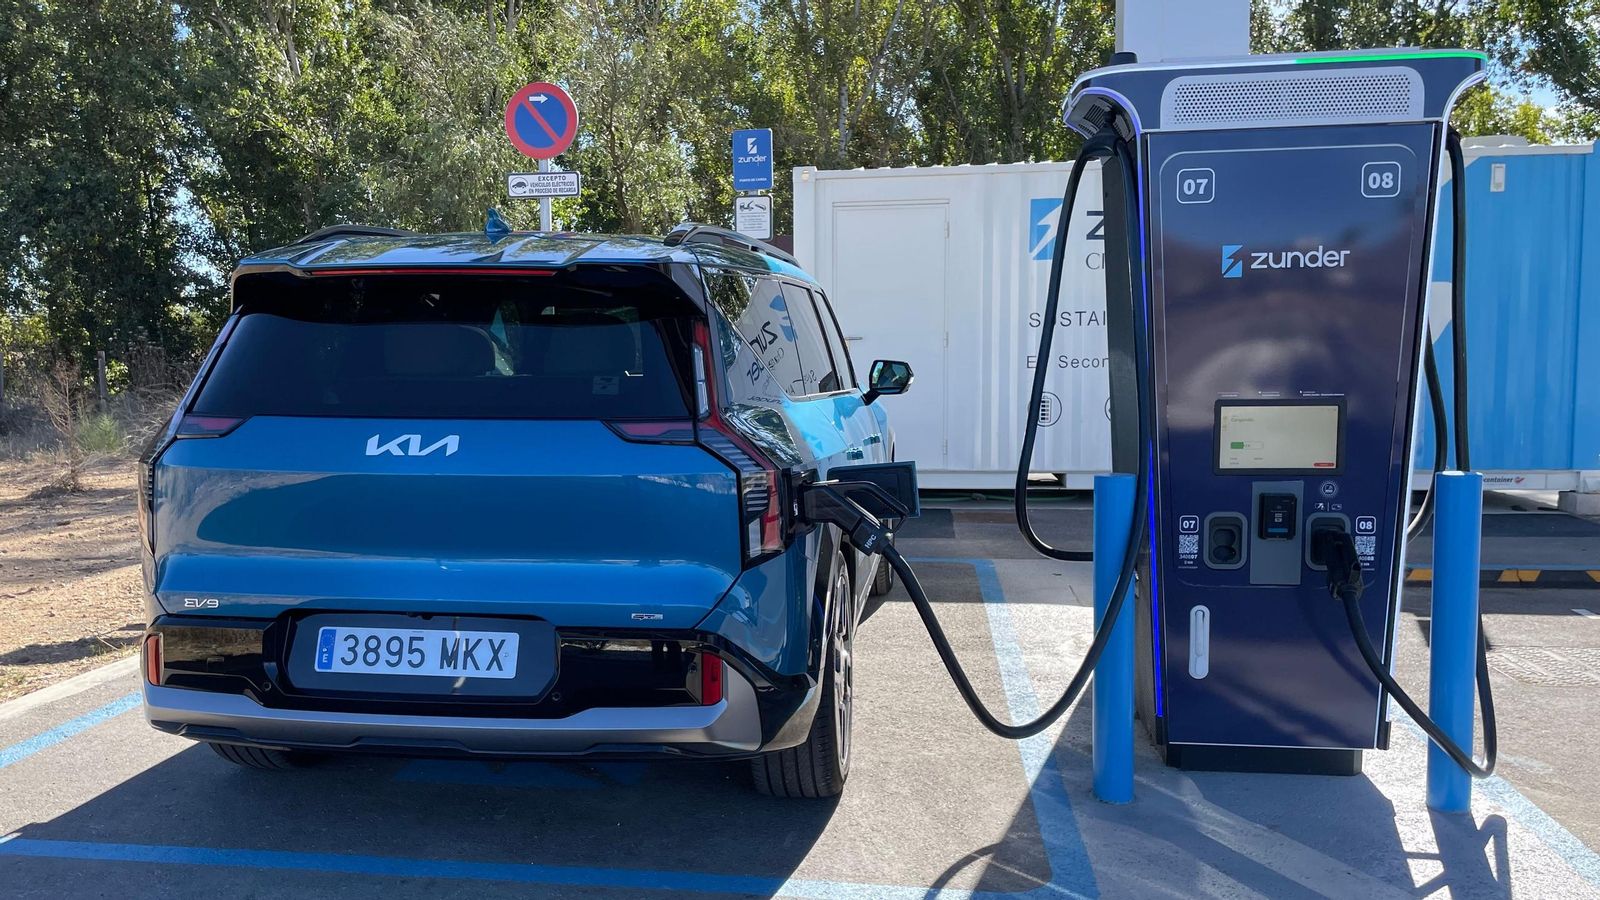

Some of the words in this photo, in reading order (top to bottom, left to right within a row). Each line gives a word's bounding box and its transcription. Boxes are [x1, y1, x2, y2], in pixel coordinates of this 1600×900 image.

[738, 155, 767, 163] zunder
[1183, 179, 1209, 196] 07
[1368, 172, 1394, 189] 08
[1250, 245, 1351, 269] zunder
[365, 433, 460, 457] KIA
[1183, 520, 1196, 529] 07
[1359, 521, 1373, 530] 08
[184, 598, 219, 608] EV9
[340, 633, 426, 669] 3895
[439, 636, 507, 672] MKX
